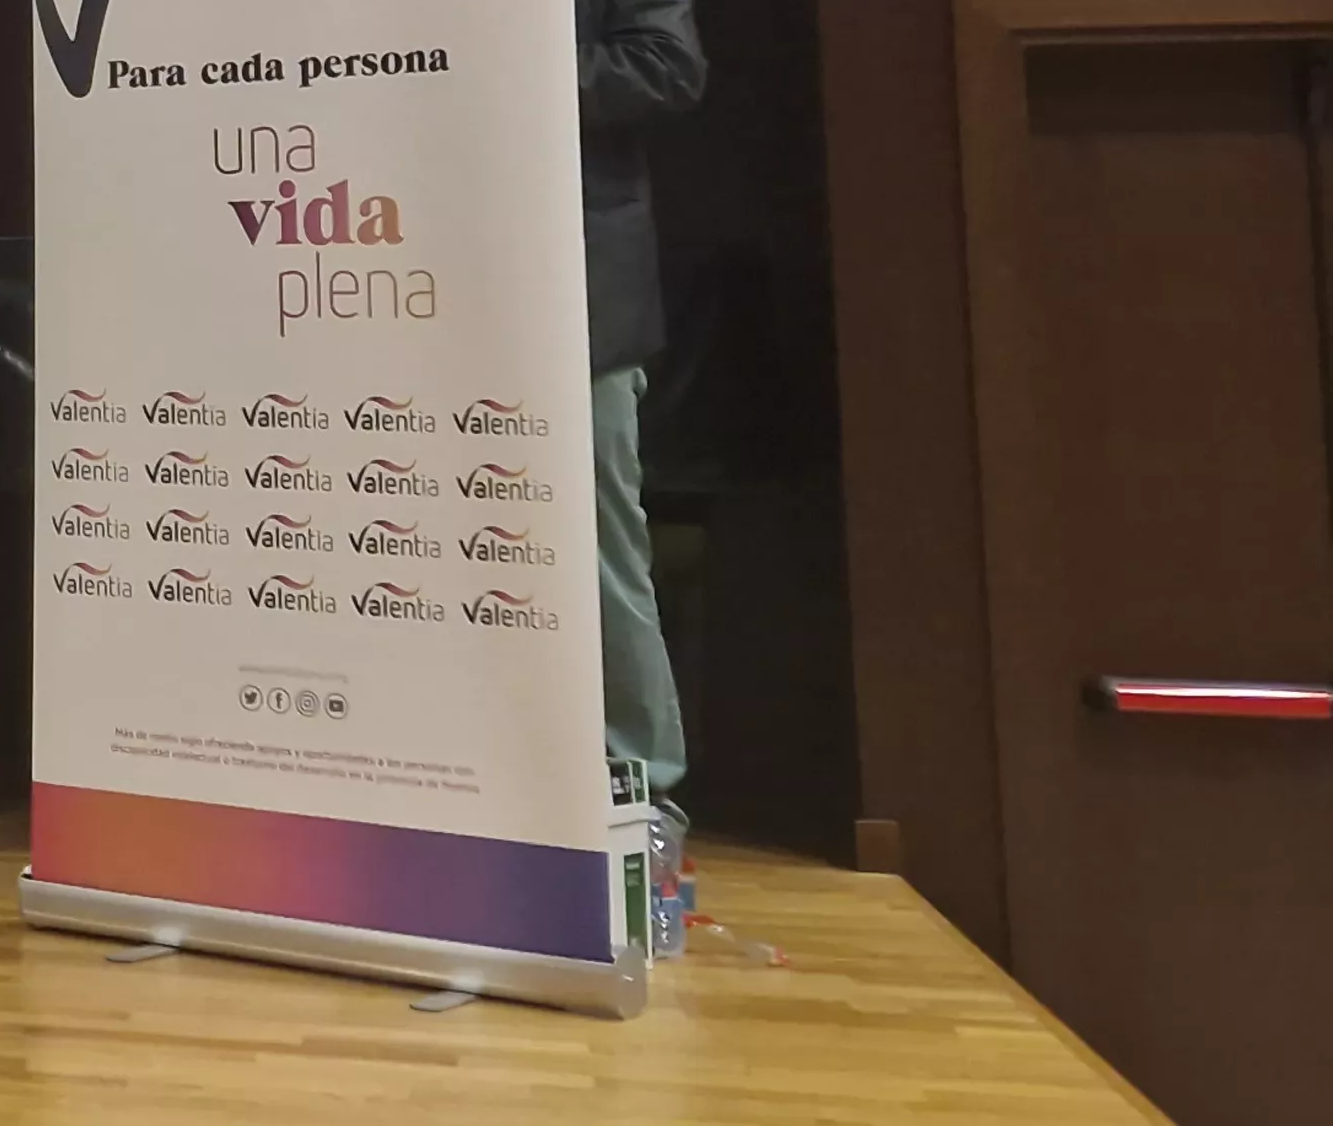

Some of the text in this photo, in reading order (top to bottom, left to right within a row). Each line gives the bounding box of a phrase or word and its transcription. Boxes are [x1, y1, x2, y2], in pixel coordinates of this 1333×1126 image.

[107, 47, 450, 89] Para cada persona
[212, 123, 316, 175] una
[228, 179, 404, 247] vida
[277, 251, 437, 338] plena
[51, 389, 126, 423] Valentia
[143, 392, 226, 426] Valentia
[242, 394, 329, 429] Valentia
[344, 396, 435, 433] Valentia
[453, 400, 549, 436] Valentia
[52, 448, 129, 483] Valentia
[145, 451, 229, 487] Valentia
[244, 455, 332, 492] Valentia
[347, 459, 439, 497] Valentia
[456, 464, 553, 502] Valentia
[52, 504, 130, 540] Valentia
[146, 509, 230, 545] Valentia
[245, 515, 334, 551] Valentia
[348, 520, 442, 558] Valentia
[458, 526, 556, 566] Valentia
[53, 563, 133, 598] Valentia
[148, 569, 232, 605] Valentia
[248, 575, 336, 613] Valentia
[351, 583, 445, 621] Valentia
[461, 590, 559, 630] Valentia
